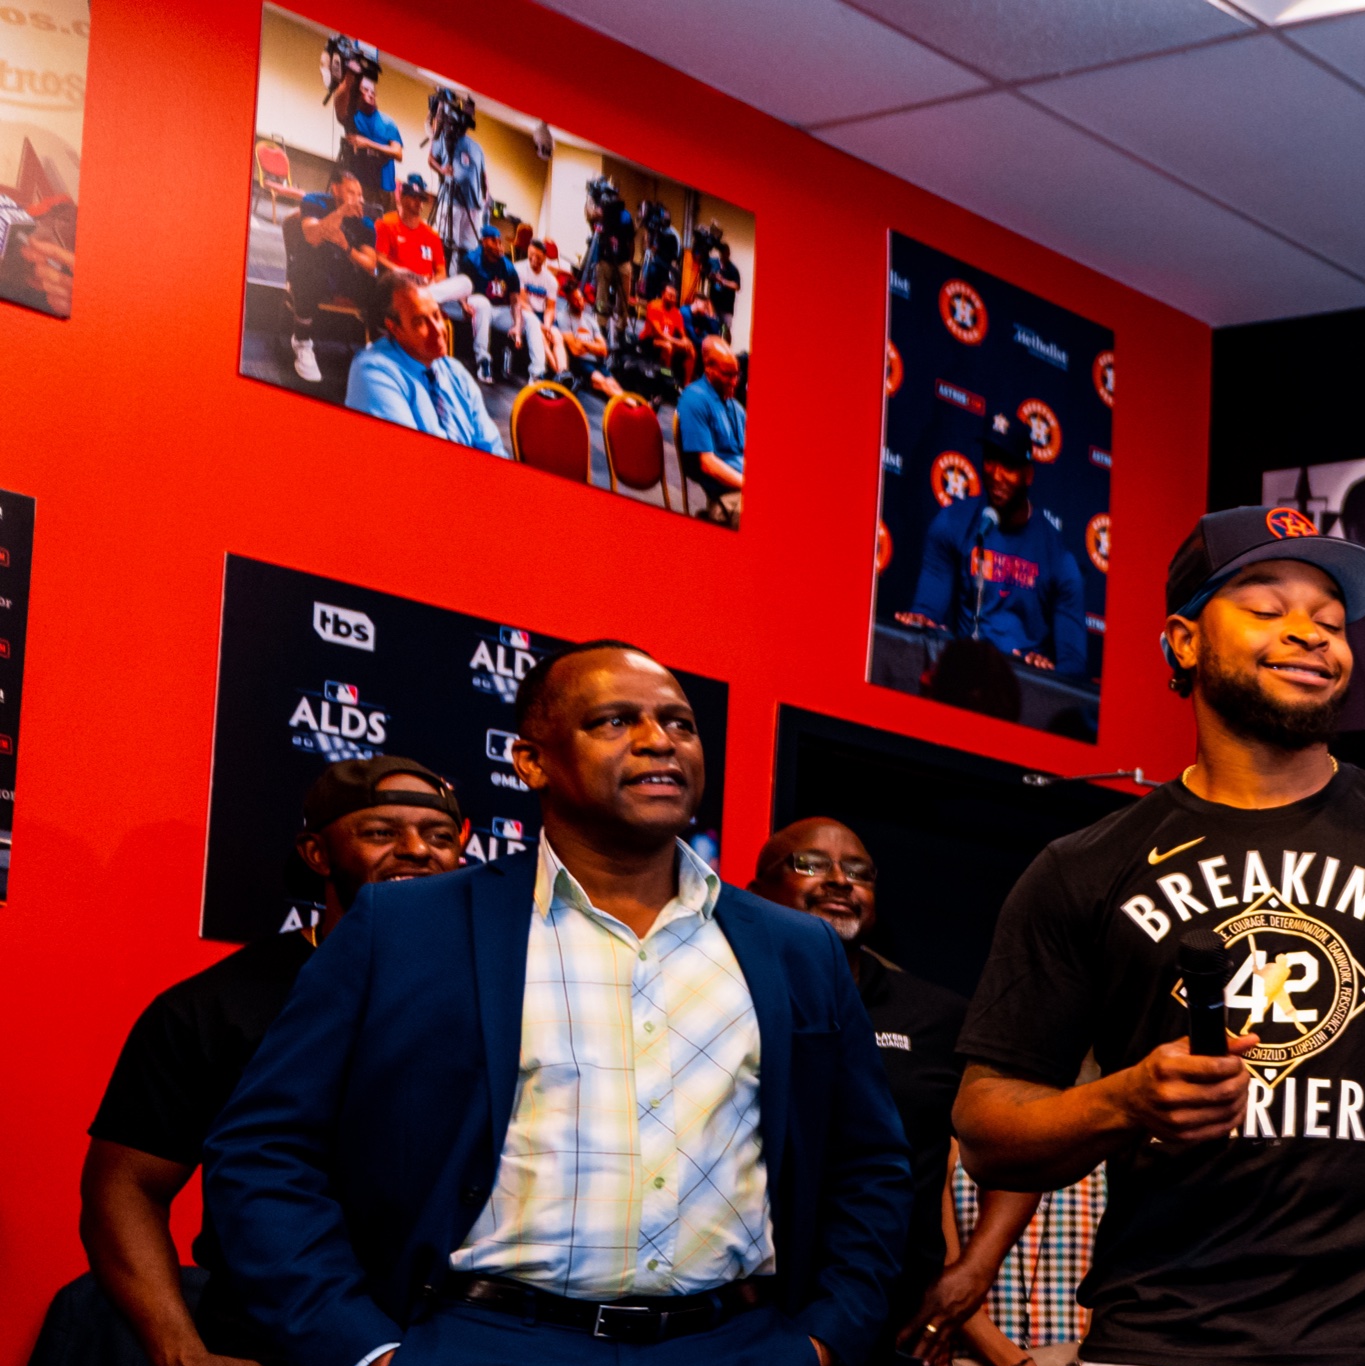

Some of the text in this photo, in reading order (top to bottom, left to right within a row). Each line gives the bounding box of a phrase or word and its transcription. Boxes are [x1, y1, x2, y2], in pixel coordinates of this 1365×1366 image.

[320, 609, 369, 643] tbs
[469, 640, 542, 680] ALD
[289, 696, 387, 745] ALDS
[1228, 915, 1269, 935] COURAGE.
[1270, 915, 1328, 945] DETERMINATION.
[1327, 939, 1353, 986] TEAMWORK.
[1224, 950, 1319, 1023] 42
[1288, 1032, 1328, 1057] INTEGRITY.
